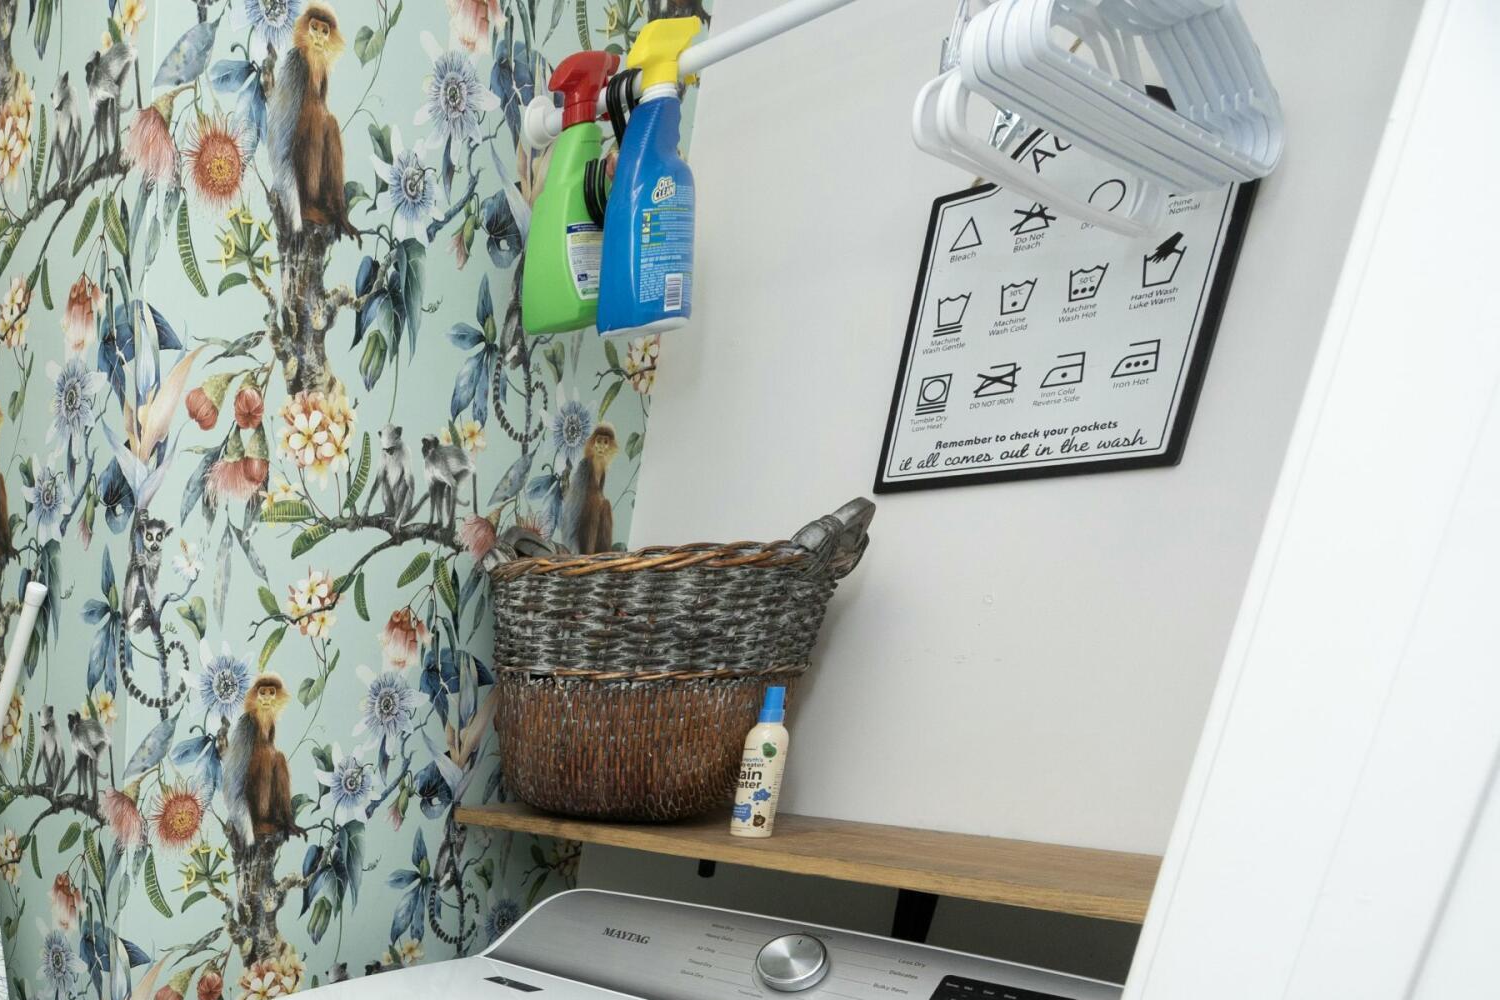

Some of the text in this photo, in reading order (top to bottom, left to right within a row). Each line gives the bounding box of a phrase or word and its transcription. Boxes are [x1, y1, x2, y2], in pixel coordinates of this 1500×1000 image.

[1014, 232, 1046, 245] Do Not
[1013, 242, 1041, 253] Bleach
[949, 251, 977, 263] Bleach
[1130, 287, 1179, 301] Hand Wash
[1062, 303, 1097, 314] Machine
[1128, 296, 1176, 310] Luke Warm
[993, 316, 1026, 328] Machine
[1058, 311, 1097, 323] Wash Hot
[988, 324, 1028, 336] Wash Cold
[930, 336, 960, 347] Machine
[922, 341, 966, 355] Wash Gentle
[1112, 377, 1149, 389] Iron Hot
[1040, 387, 1076, 398] Iron Cold
[981, 399, 996, 408] NOT
[997, 398, 1015, 406] IRON
[1032, 395, 1081, 407] Reverse Side
[910, 415, 948, 426] Tumble Dry
[935, 420, 1118, 449] Remember to check your pockets
[899, 429, 1147, 471] it all comes out in the wash
[740, 767, 762, 780] ain
[602, 927, 650, 945] MAYTAG
